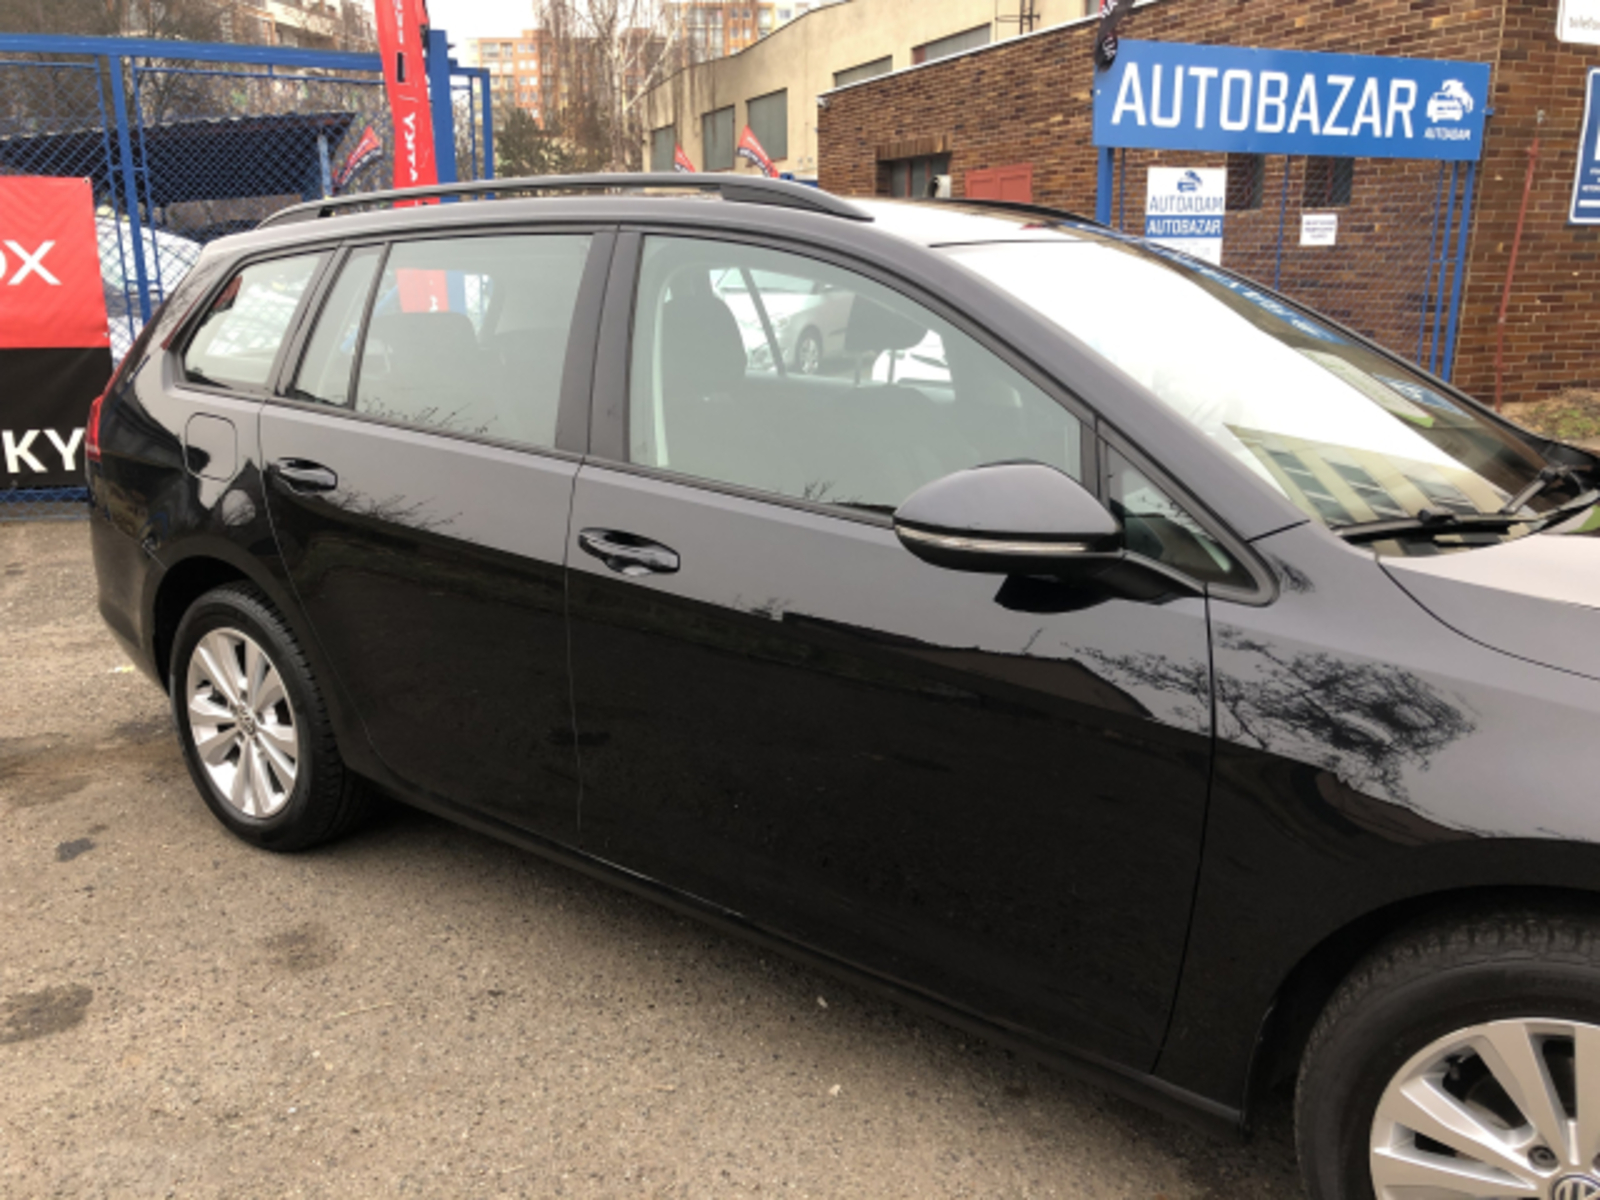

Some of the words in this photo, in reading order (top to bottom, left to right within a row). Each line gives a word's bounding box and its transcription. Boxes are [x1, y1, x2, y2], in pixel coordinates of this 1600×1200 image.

[1111, 61, 1418, 139] AUTOBAZAR
[1149, 194, 1223, 213] AUTOADAM
[1146, 219, 1221, 236] AUTOBAZAR
[0, 239, 63, 286] X
